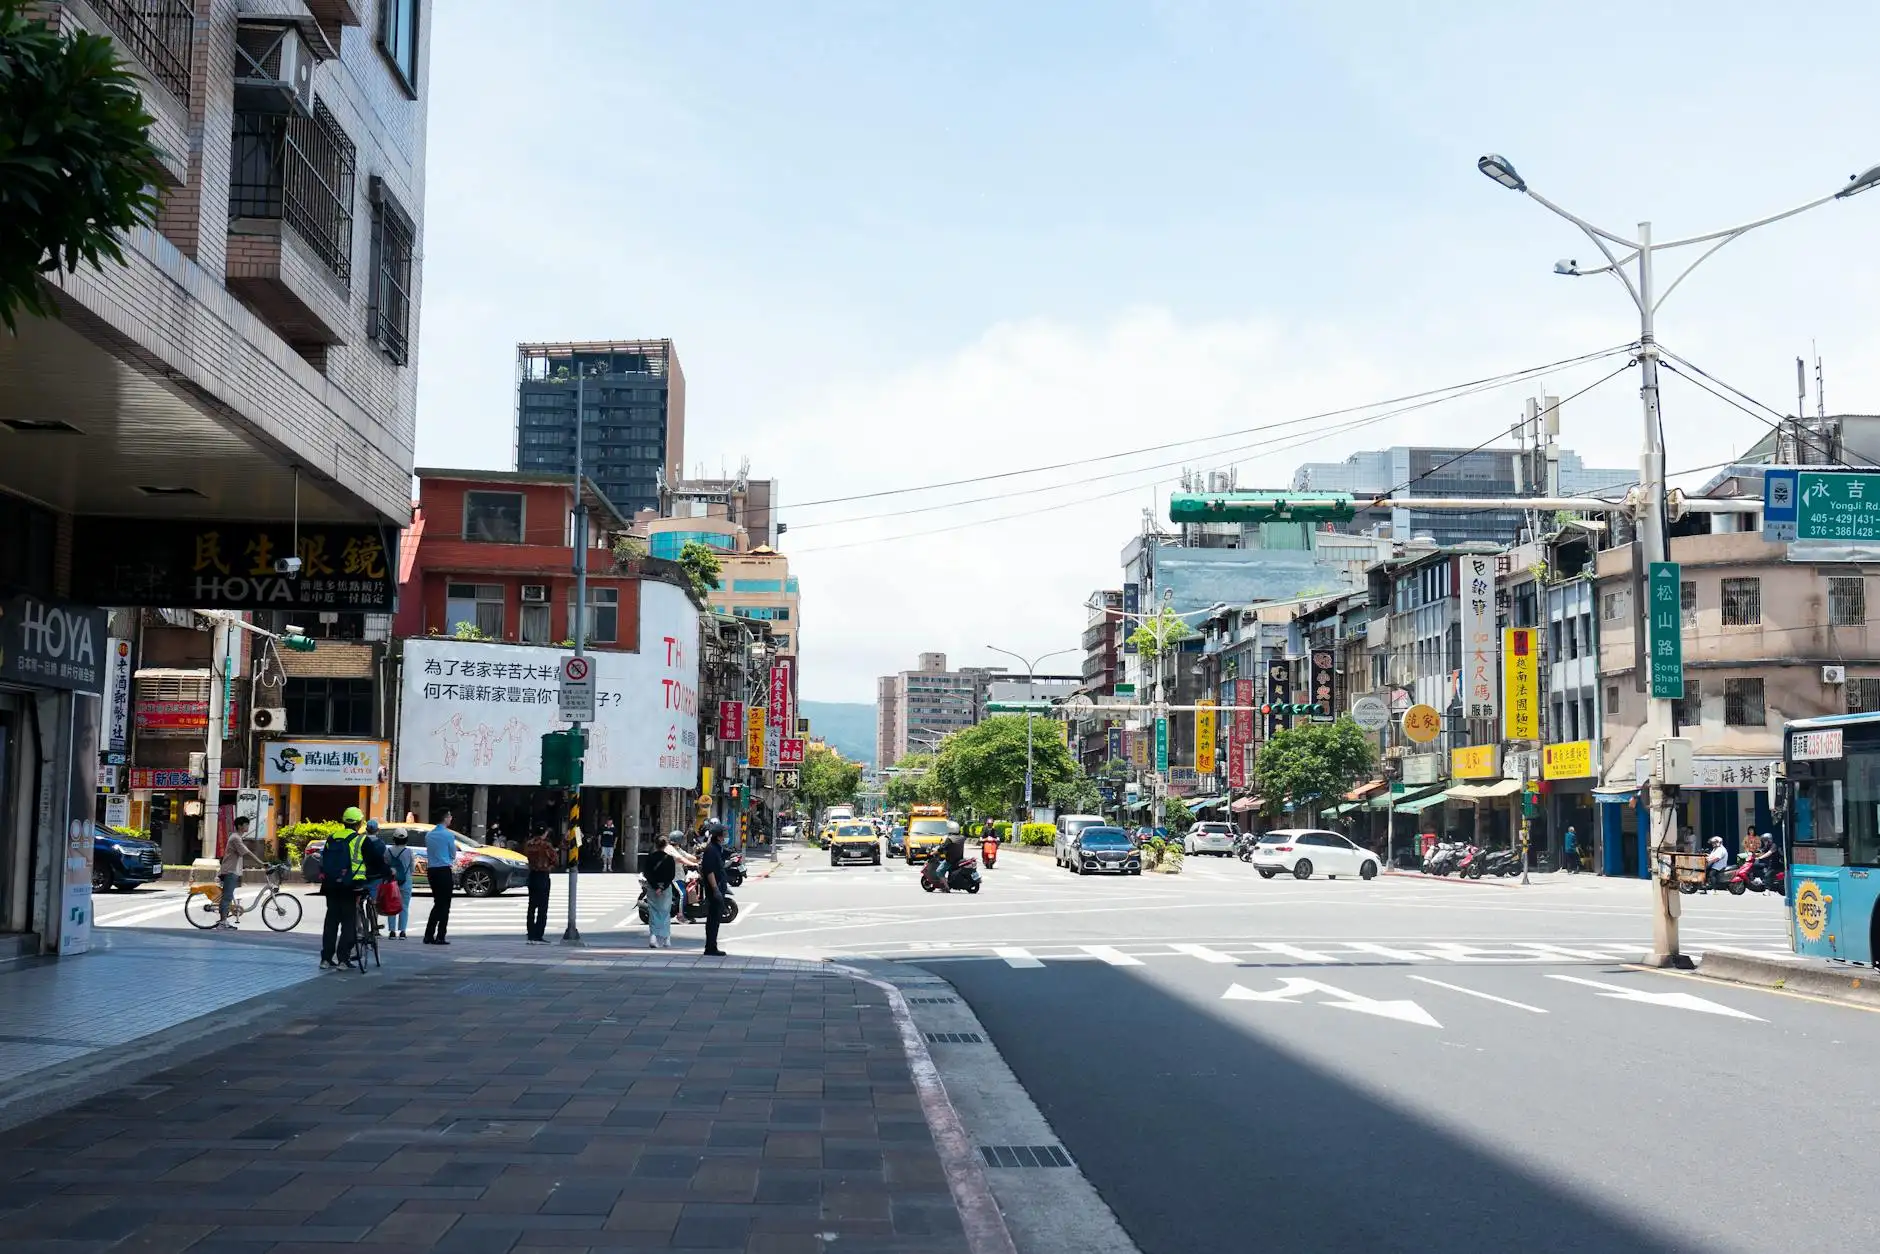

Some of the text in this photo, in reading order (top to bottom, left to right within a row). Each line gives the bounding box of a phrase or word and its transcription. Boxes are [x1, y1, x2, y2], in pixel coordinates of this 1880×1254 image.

[1812, 478, 1866, 499] 永吉
[1830, 501, 1862, 512] YongJi
[192, 531, 385, 579] 民生眼鏡
[190, 576, 294, 602] HOYA
[1657, 584, 1674, 656] 松山路
[20, 600, 95, 666] HOYA
[1473, 632, 1491, 701] 加大尺碼
[1654, 662, 1679, 674] Song
[1654, 674, 1679, 683] Shan
[1654, 685, 1670, 694] Rd.
[1471, 704, 1493, 716] 服飾
[305, 751, 358, 766] 酷嗑斯
[1798, 902, 1822, 918] UPF50+
